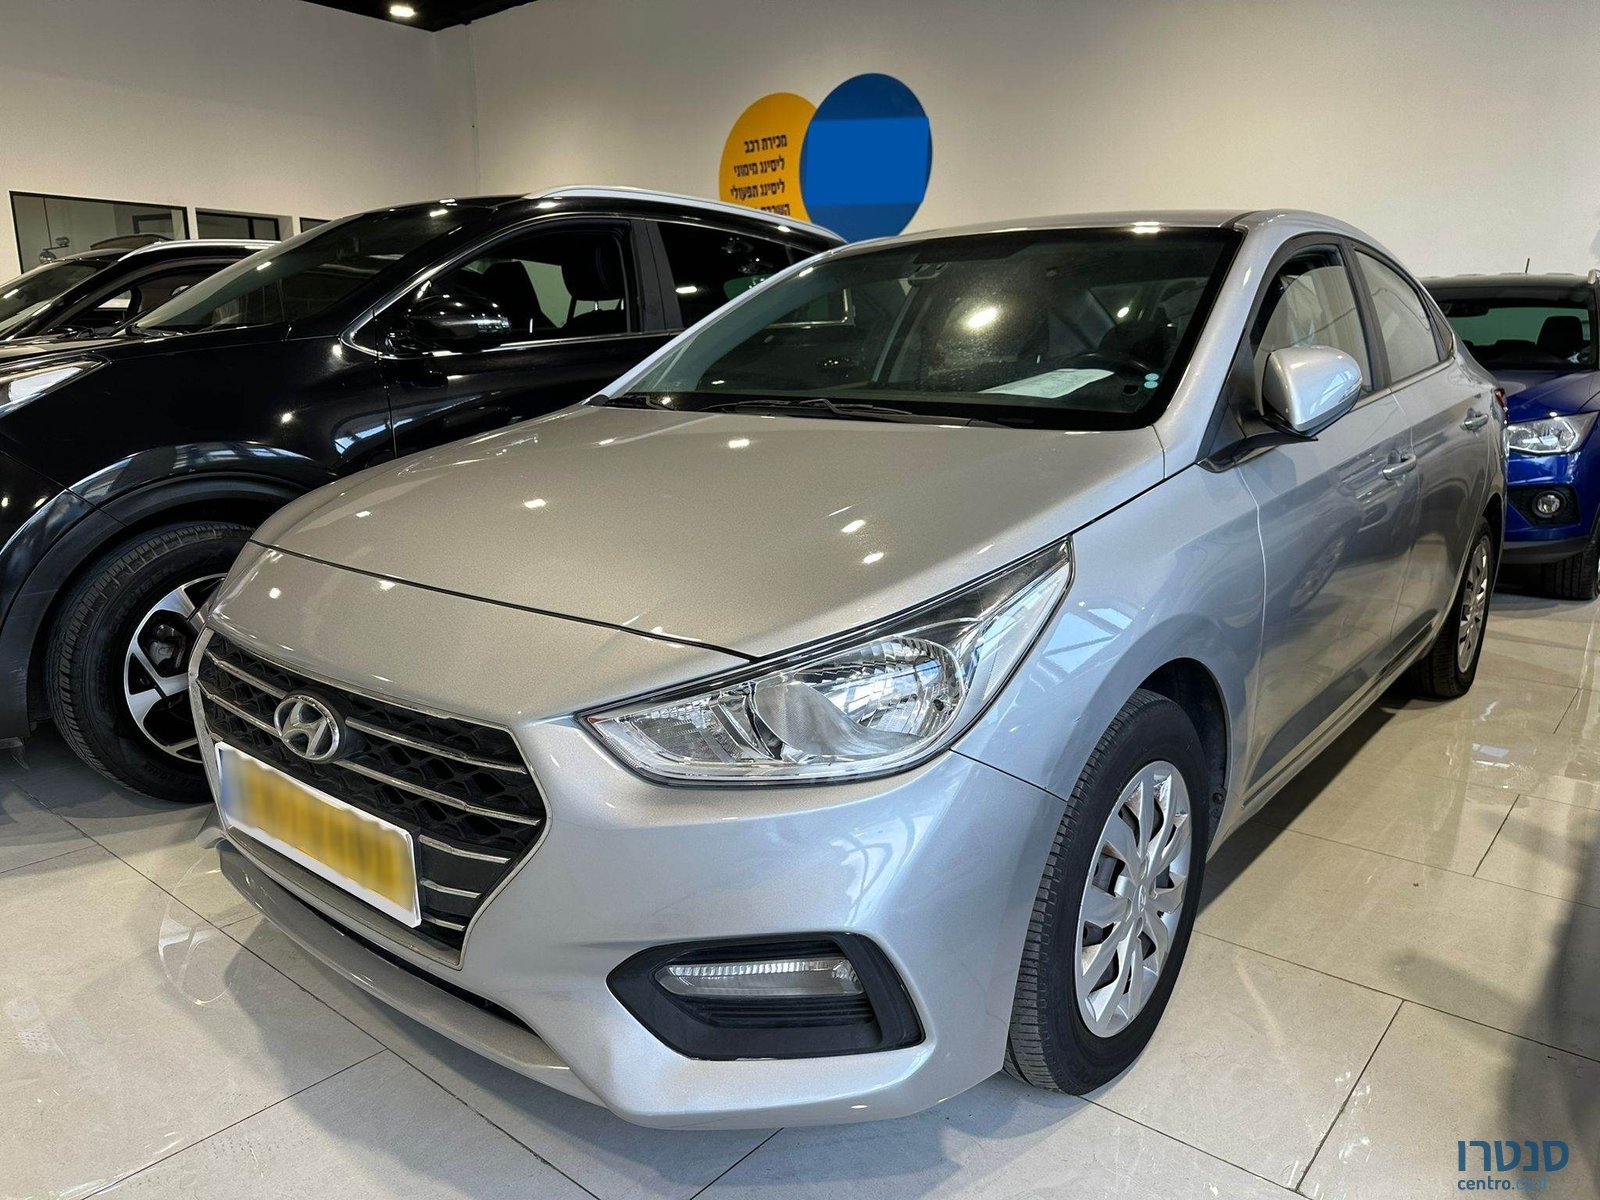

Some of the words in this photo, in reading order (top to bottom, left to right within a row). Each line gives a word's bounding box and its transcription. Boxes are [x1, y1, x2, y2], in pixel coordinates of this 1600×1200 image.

[744, 139, 760, 154] רכב
[761, 134, 788, 151] מכירת
[760, 154, 785, 174] ליסינג
[730, 184, 759, 201] תפעולי
[760, 178, 785, 196] ליסינג
